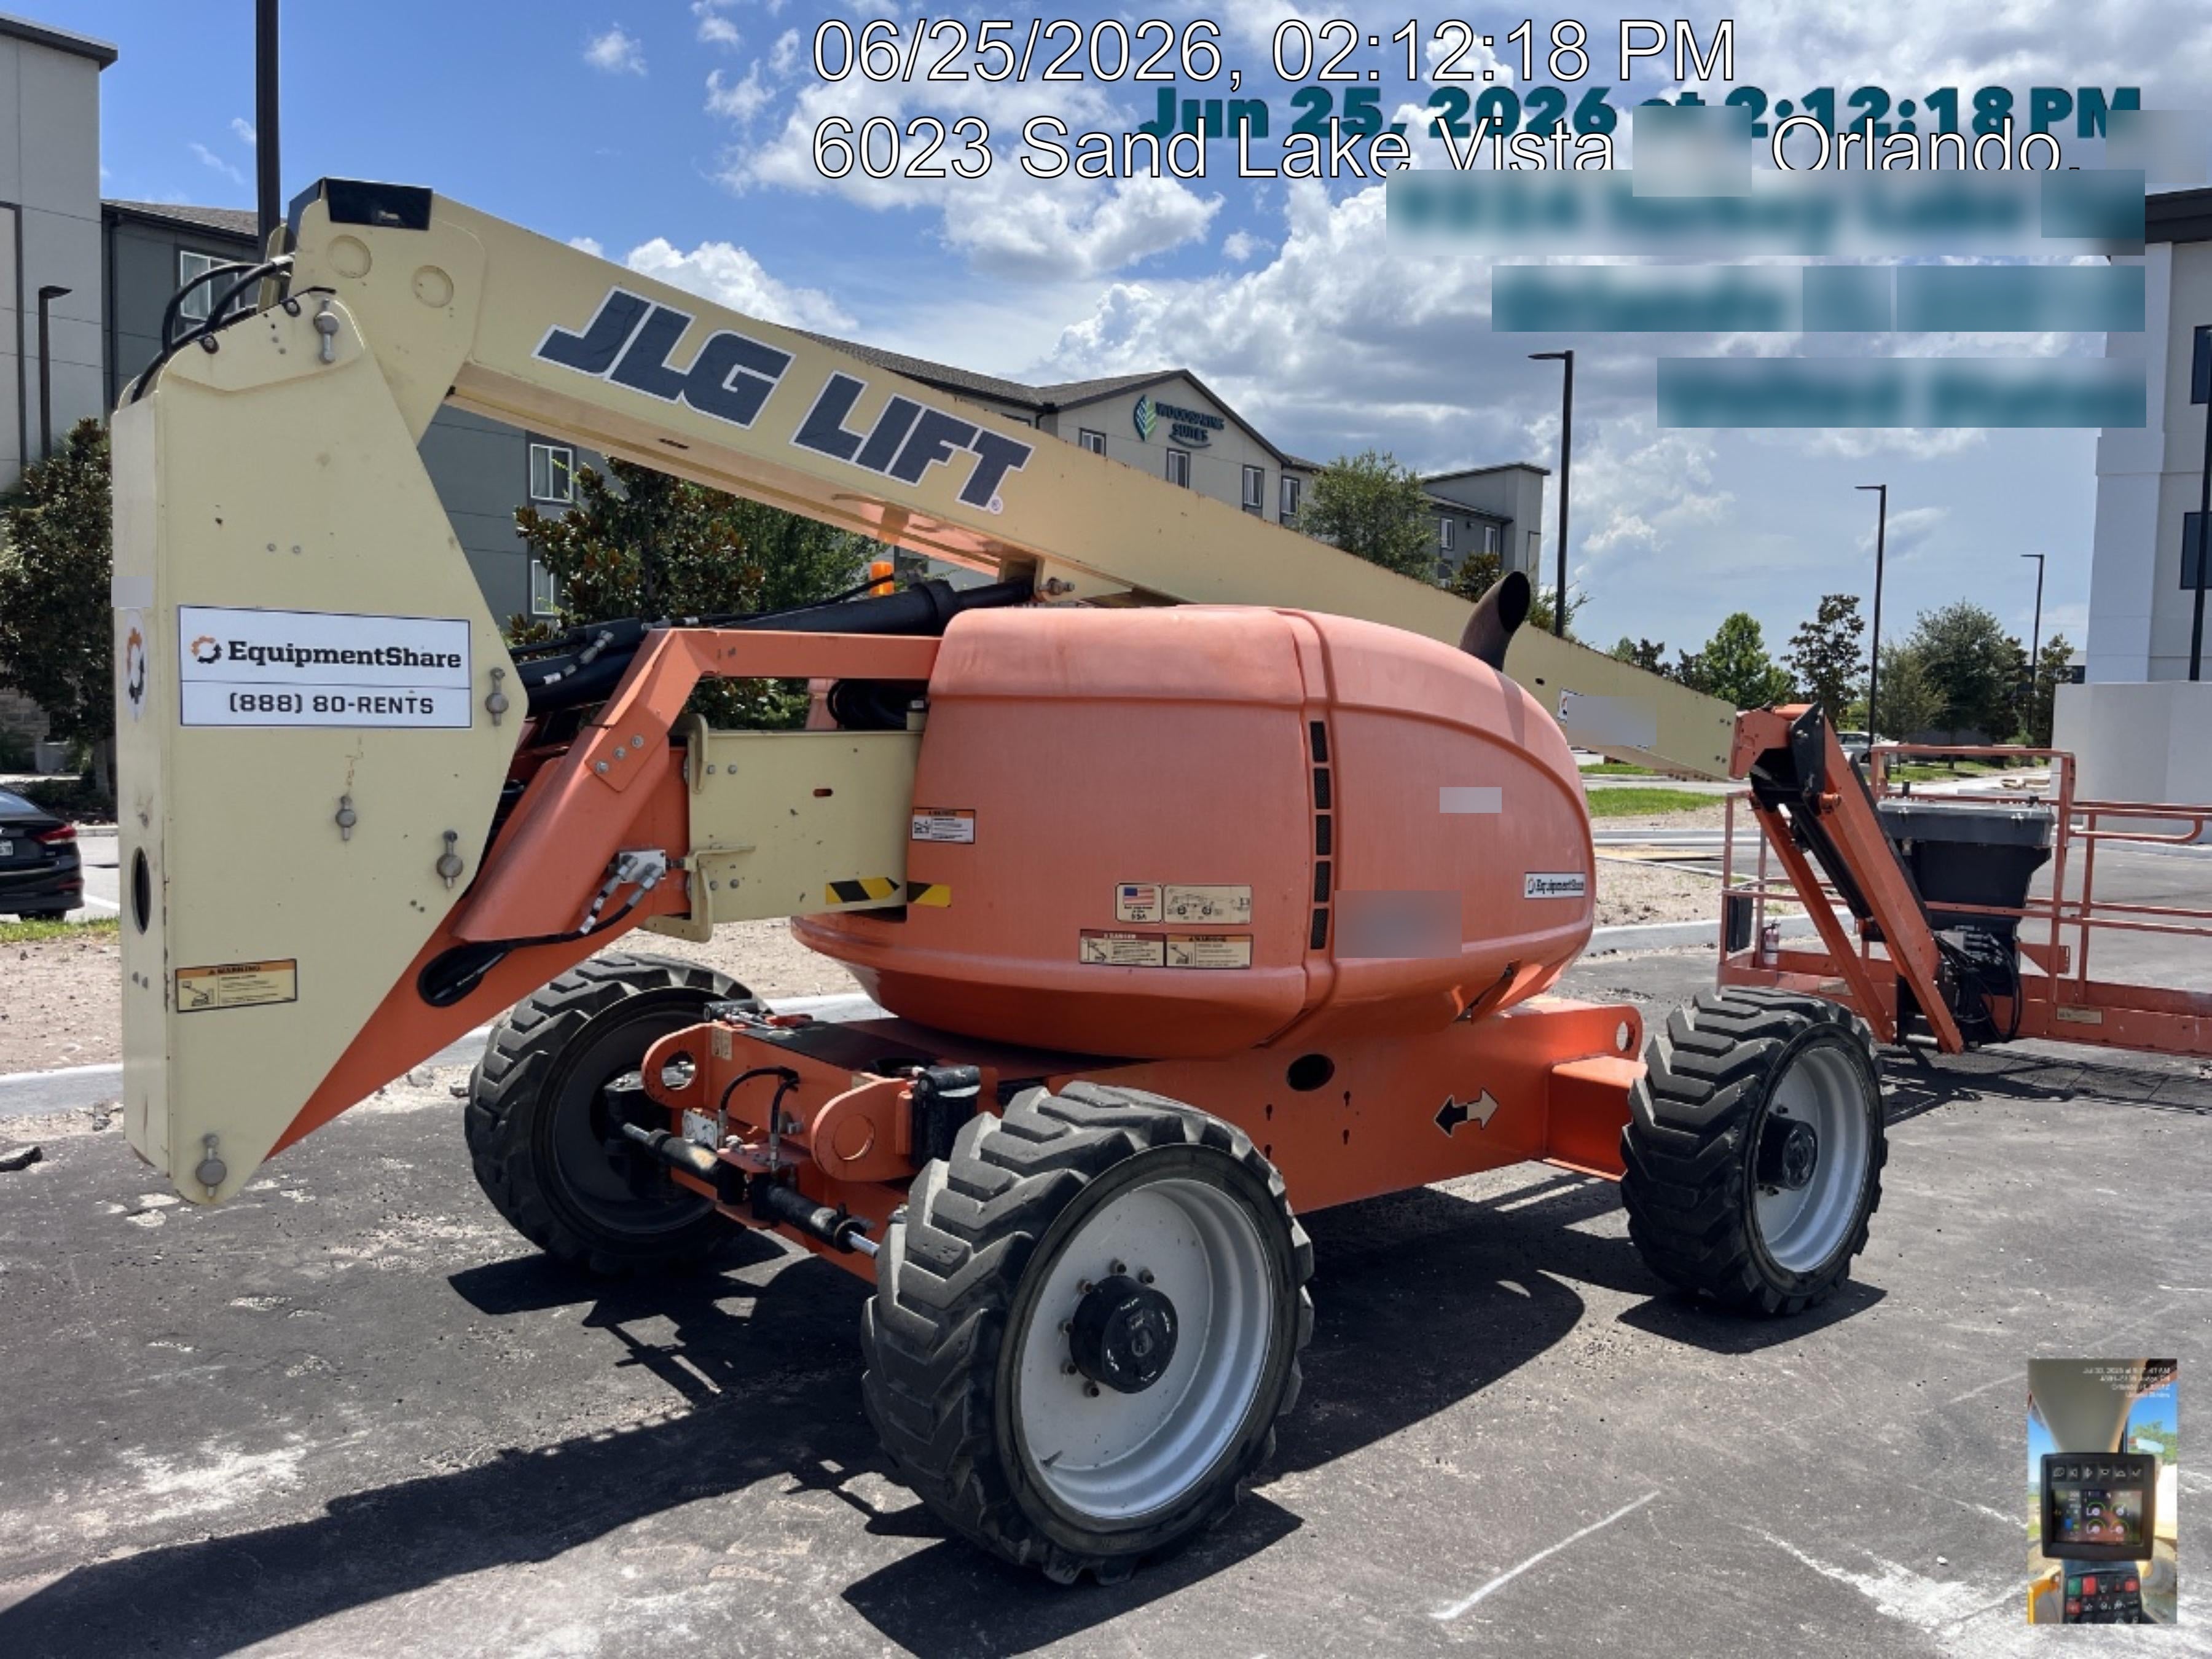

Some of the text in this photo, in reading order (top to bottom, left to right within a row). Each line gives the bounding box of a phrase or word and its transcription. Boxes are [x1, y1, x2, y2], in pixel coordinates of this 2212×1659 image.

[530, 285, 1035, 509] JLG LIFT
[229, 640, 461, 669] EquipmentShare
[229, 692, 434, 714] (888) 80-RENTS
